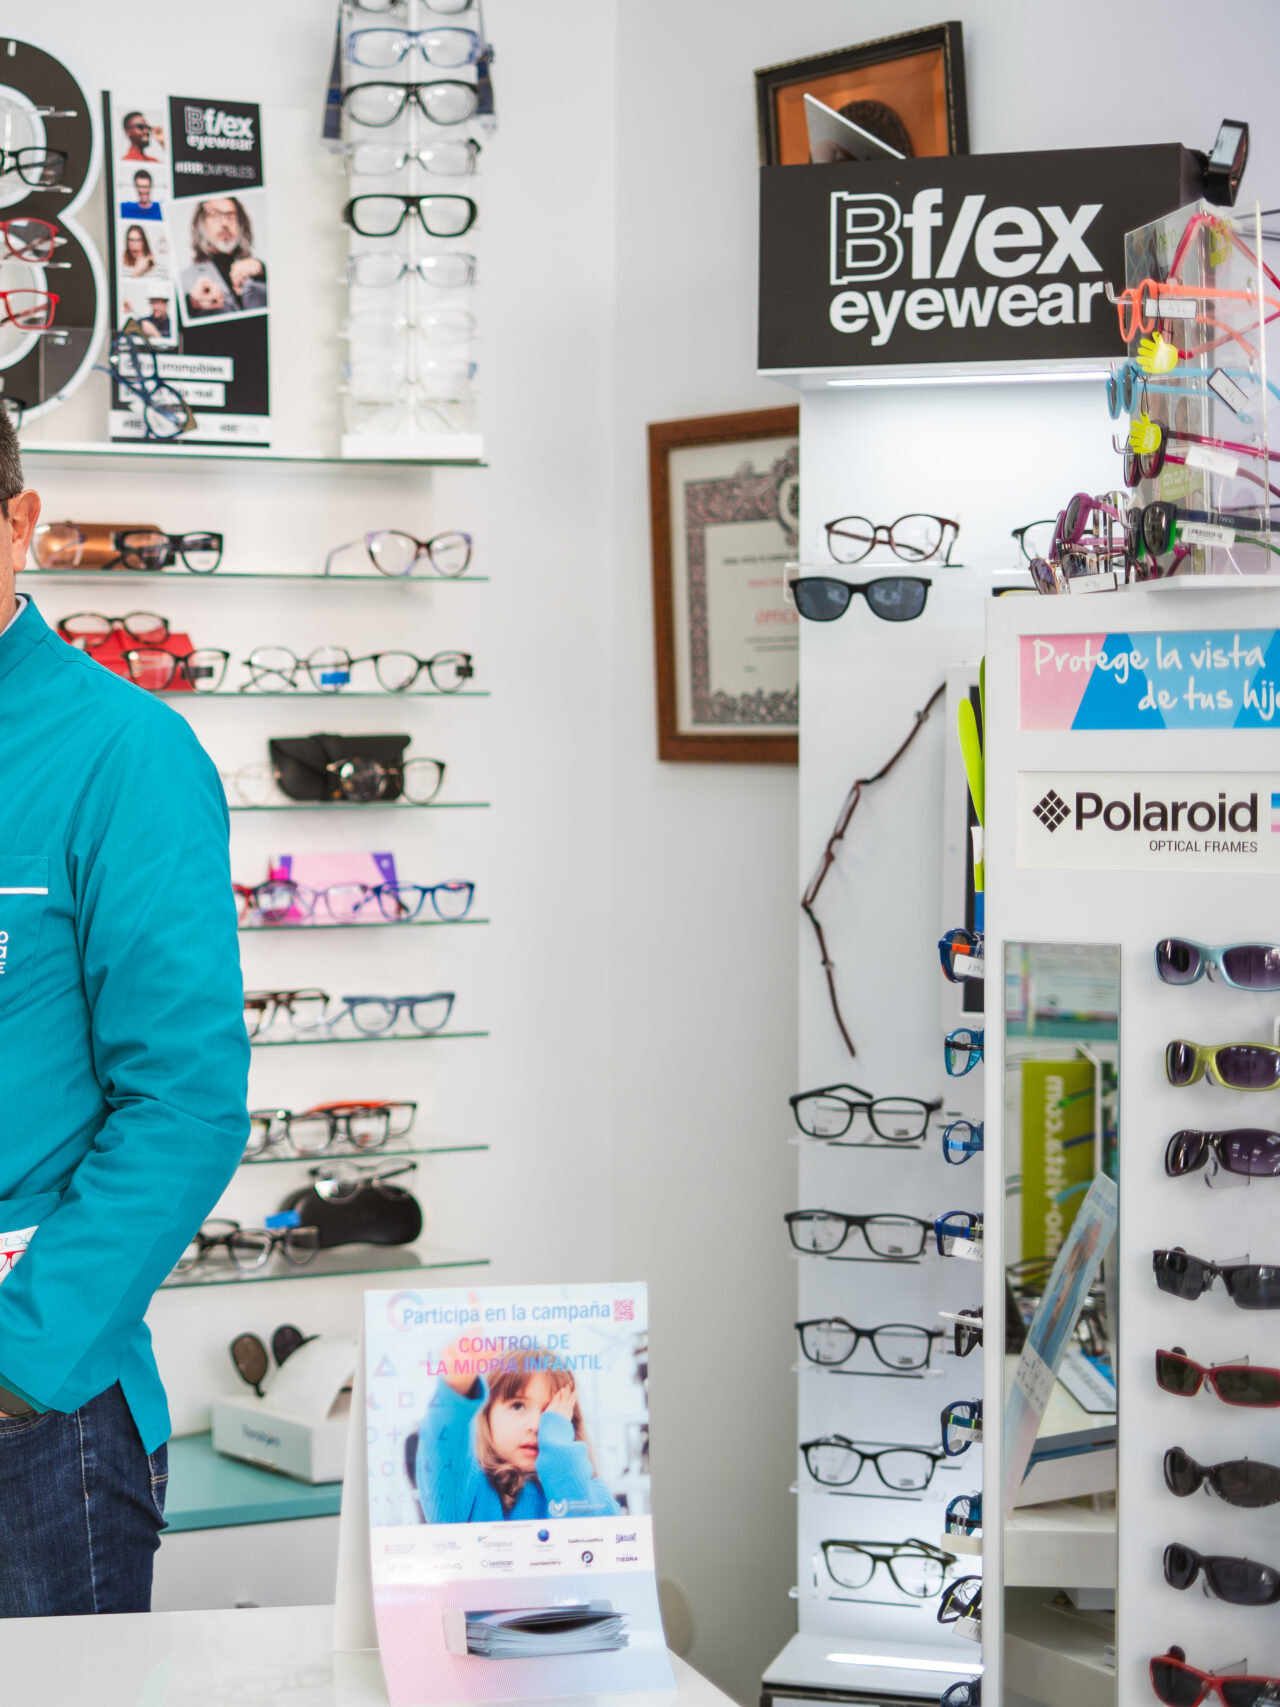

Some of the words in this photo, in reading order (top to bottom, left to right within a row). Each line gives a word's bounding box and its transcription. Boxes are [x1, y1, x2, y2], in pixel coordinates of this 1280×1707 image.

[186, 134, 255, 151] eyewear
[829, 281, 1104, 346] eyewear
[1032, 638, 1150, 685] Protege
[1156, 636, 1184, 671] la
[1190, 633, 1267, 670] vista
[1137, 680, 1179, 711] de
[1182, 676, 1234, 711] tus
[1075, 791, 1259, 833] Polaroid
[1149, 839, 1201, 853] OPTICAL
[1204, 840, 1258, 853] FRAMES
[402, 1307, 480, 1326] Participa
[485, 1308, 507, 1322] en
[511, 1303, 527, 1320] la
[531, 1301, 610, 1322] campaña
[458, 1335, 541, 1353] CONTROL
[547, 1333, 570, 1350] DE
[426, 1360, 449, 1376] LA
[454, 1354, 519, 1375] MIOPÍA
[523, 1353, 603, 1373] INFANTIL
